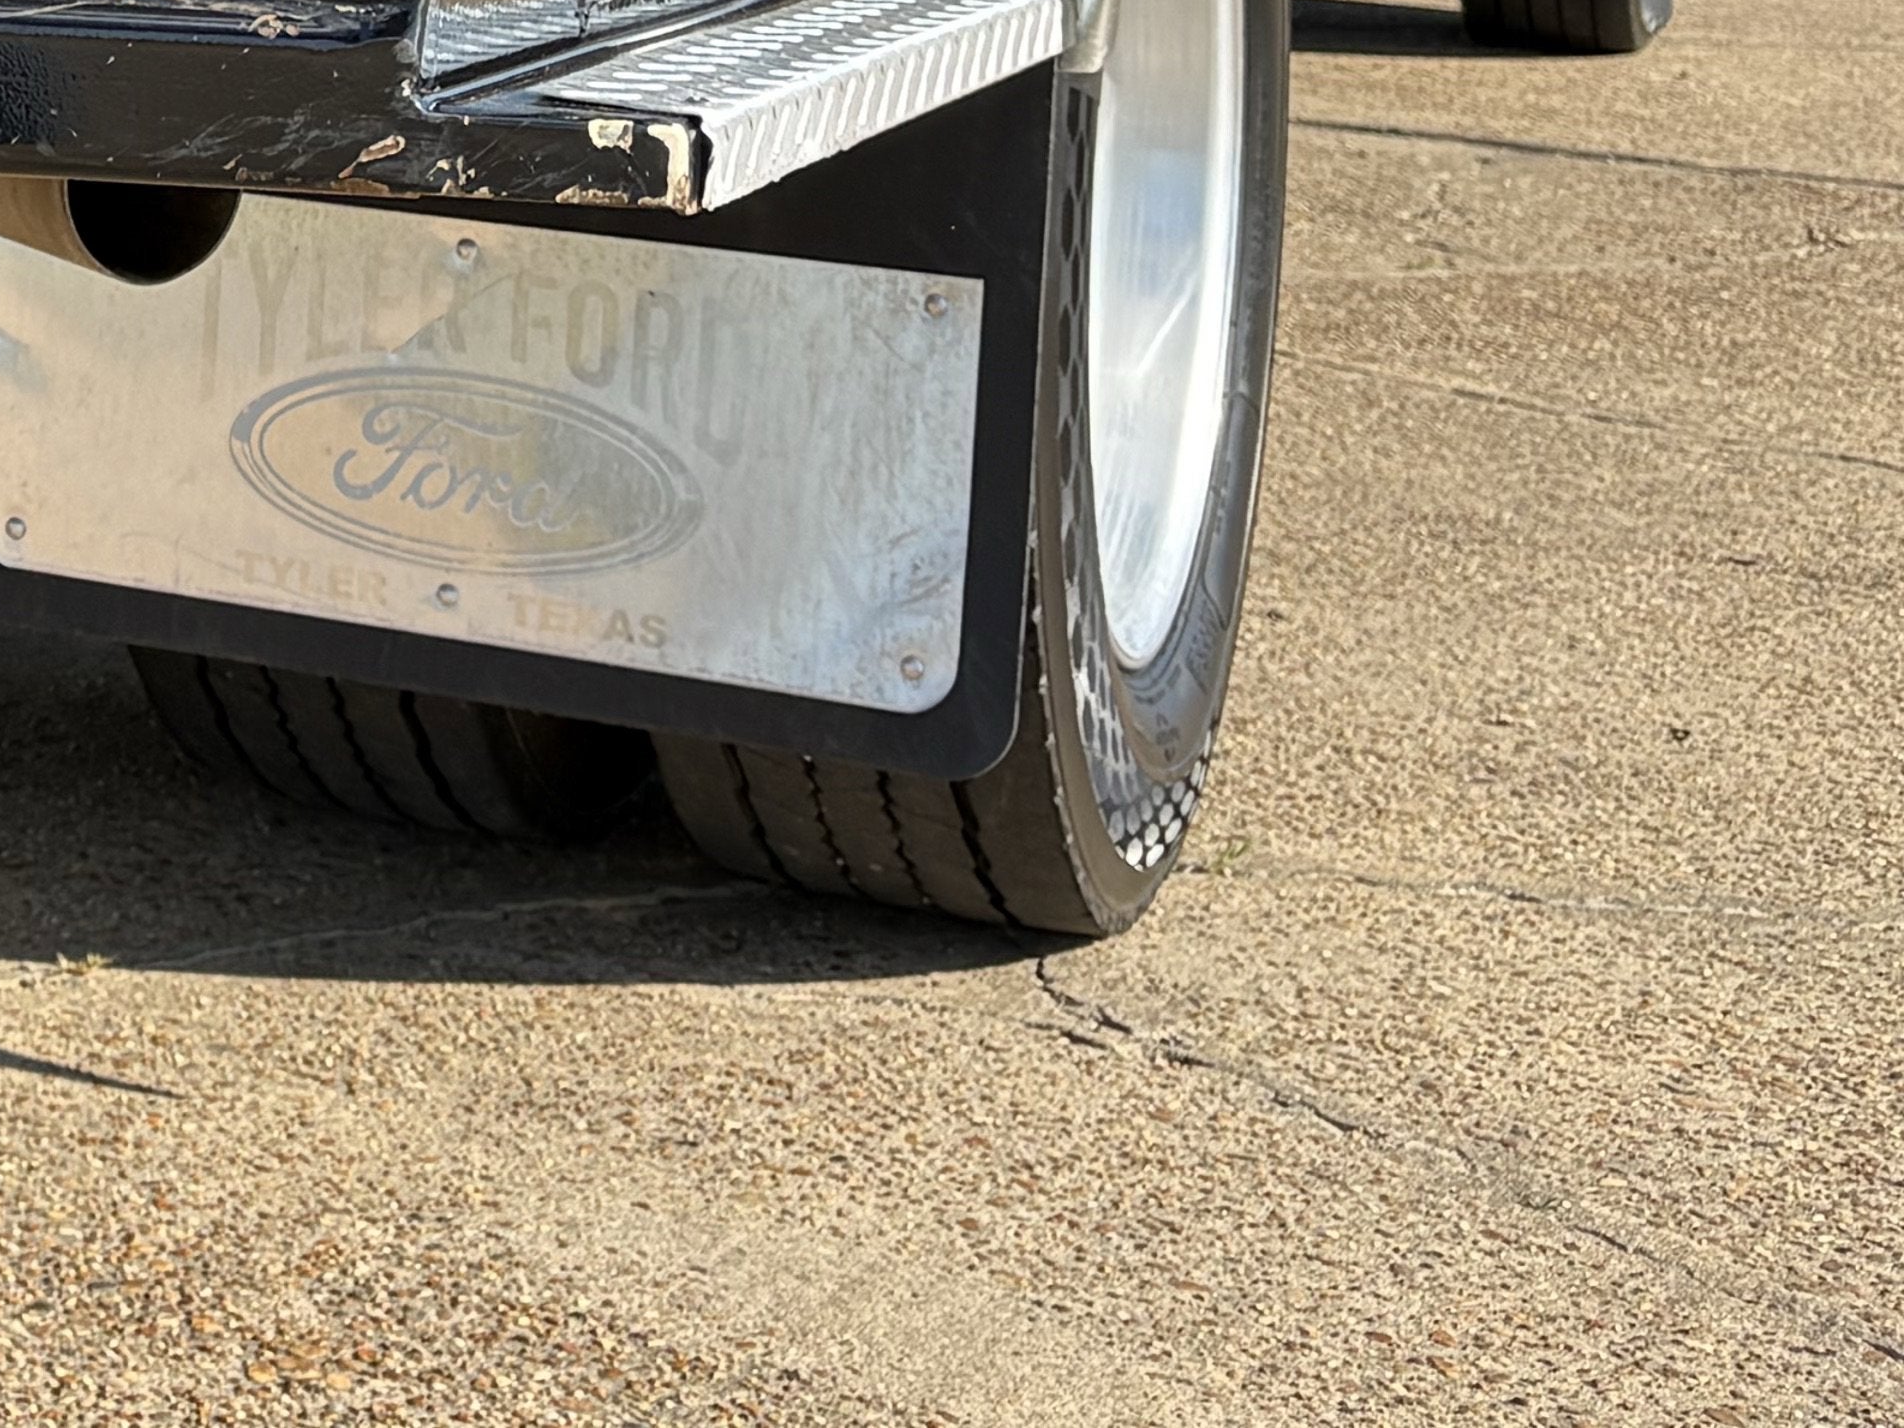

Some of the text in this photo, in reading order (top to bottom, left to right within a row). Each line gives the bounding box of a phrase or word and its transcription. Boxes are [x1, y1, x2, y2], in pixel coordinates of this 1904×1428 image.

[510, 268, 748, 466] FORD
[332, 401, 592, 532] Ford
[234, 548, 670, 649] TYLER TEXAS
